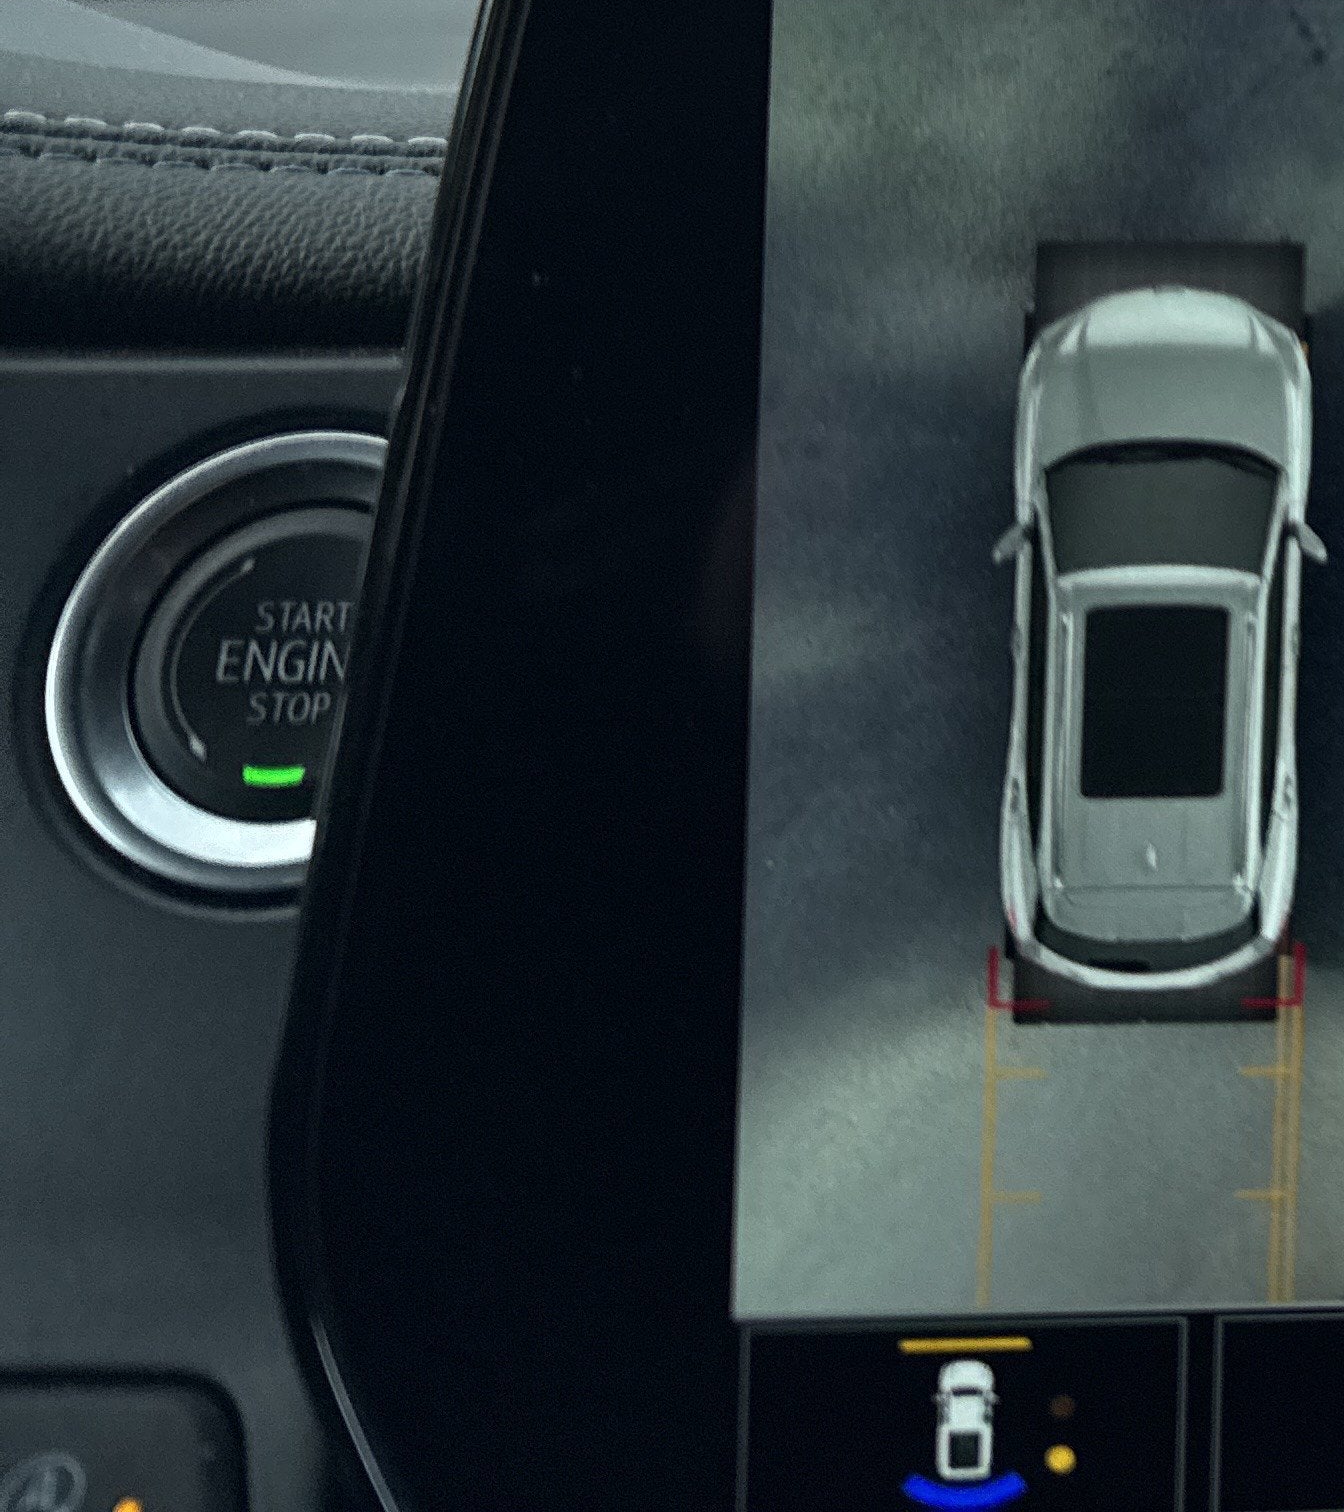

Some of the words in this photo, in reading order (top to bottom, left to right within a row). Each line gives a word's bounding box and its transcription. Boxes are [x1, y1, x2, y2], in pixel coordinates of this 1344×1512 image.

[256, 600, 352, 633] START
[215, 639, 350, 683] ENGIN
[247, 690, 332, 726] STOP
